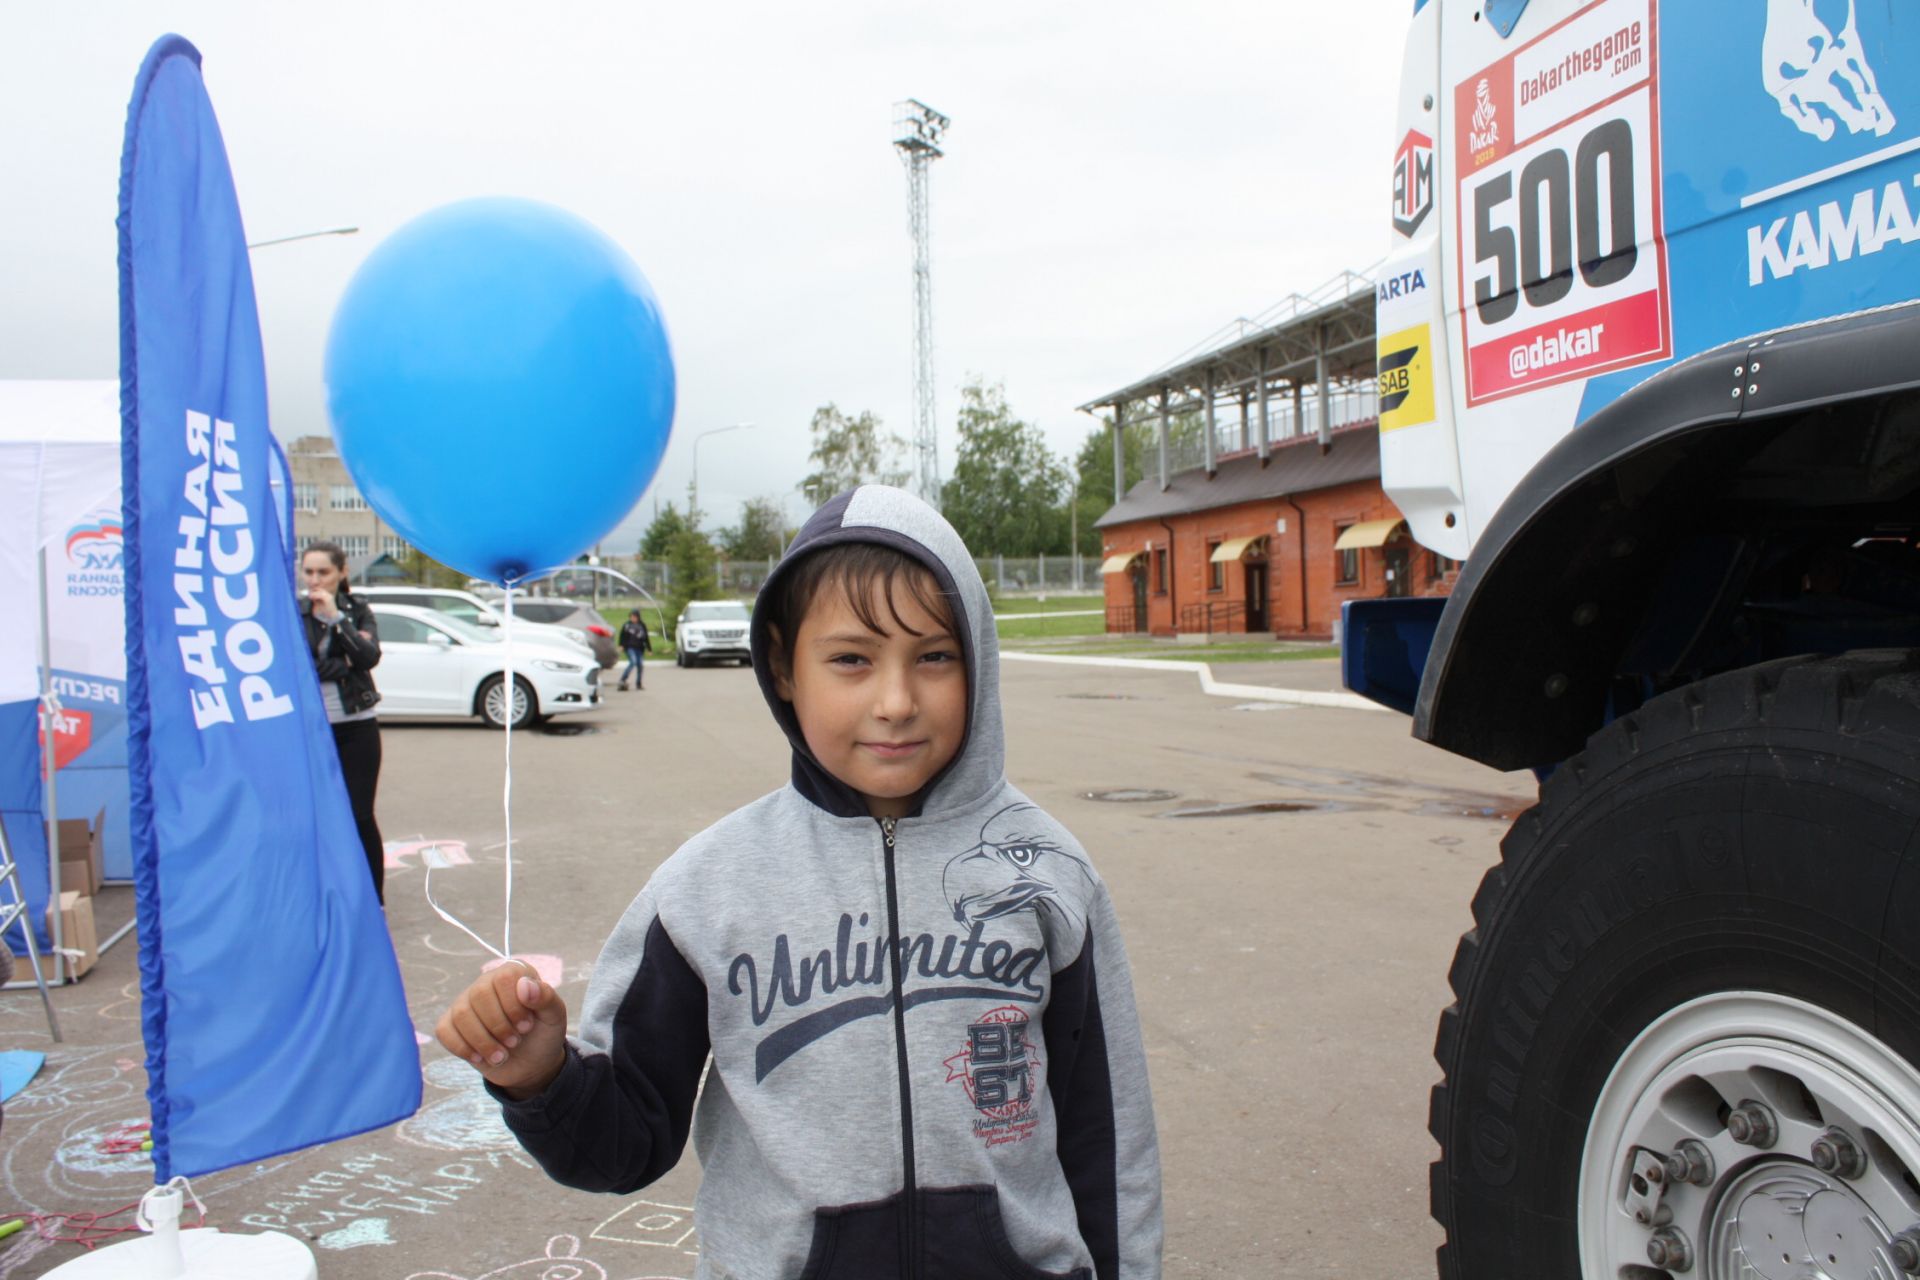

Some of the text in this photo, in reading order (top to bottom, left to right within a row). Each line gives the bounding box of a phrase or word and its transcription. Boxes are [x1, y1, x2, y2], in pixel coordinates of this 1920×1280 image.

[1520, 20, 1641, 106] Dakarthegame
[1611, 47, 1642, 78] .com
[1474, 118, 1638, 325] 500
[1747, 173, 1920, 287] KAMA
[1509, 323, 1604, 379] @dakar
[174, 409, 235, 730] ЕДИНАЯ
[209, 418, 294, 721] РОССИЯ
